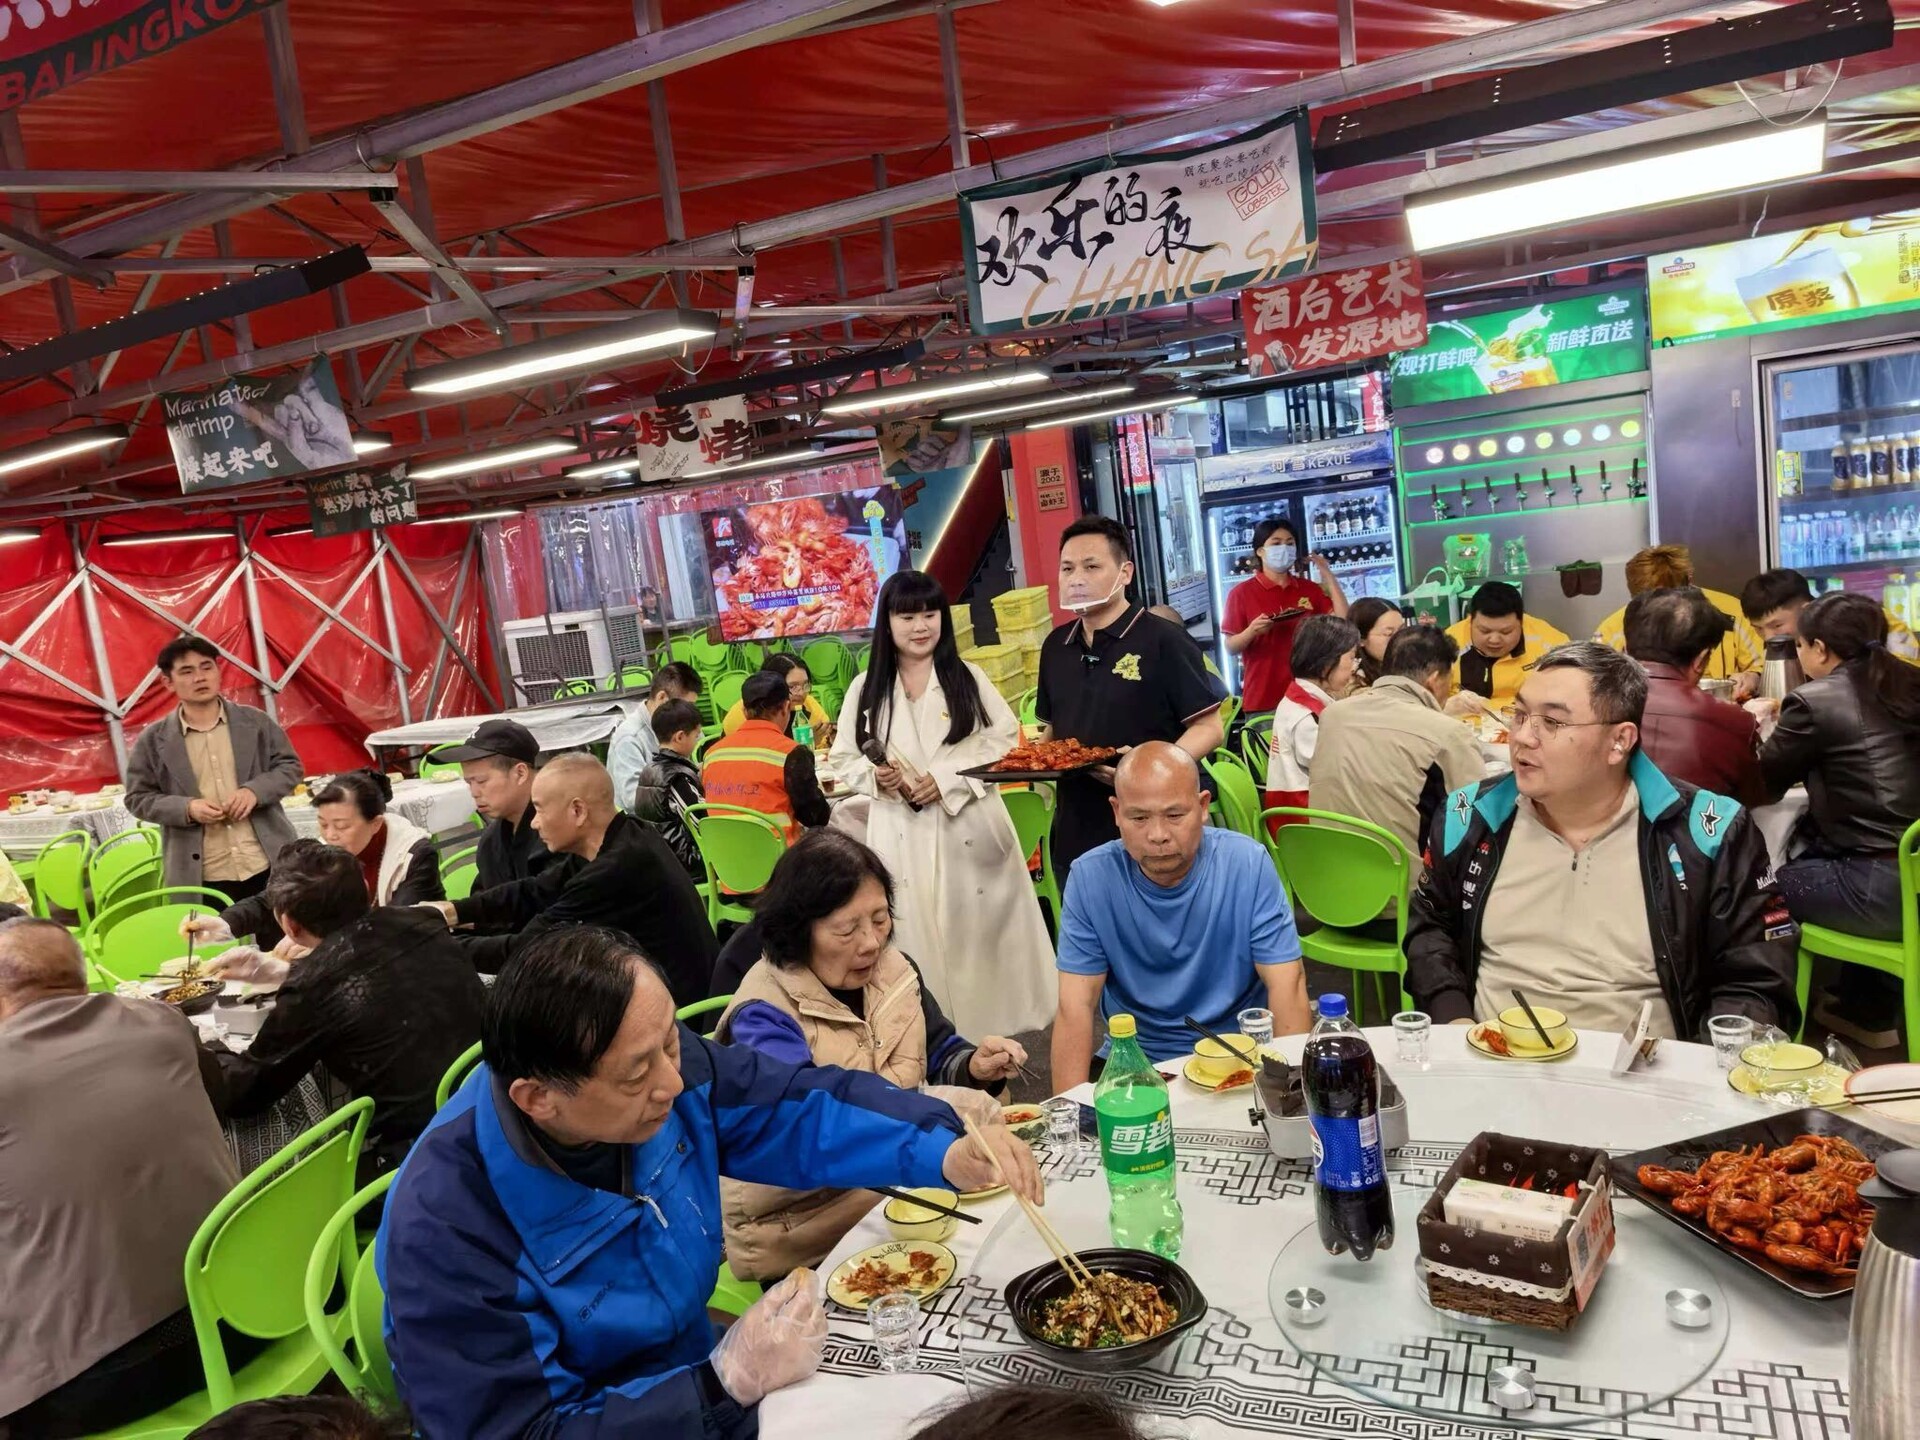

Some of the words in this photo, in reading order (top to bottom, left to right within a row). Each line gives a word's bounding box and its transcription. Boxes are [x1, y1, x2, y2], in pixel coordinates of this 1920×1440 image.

[1235, 160, 1275, 204] GOLD
[1242, 184, 1285, 216] LOBSTER
[1252, 258, 1420, 335] 酒后艺术
[1766, 286, 1835, 311] 原浆
[1299, 310, 1424, 366] 发源地
[1546, 318, 1634, 353] 新鲜直送
[1397, 346, 1478, 376] 现打鲜啤
[1308, 453, 1352, 469] KEXUE
[1041, 475, 1061, 484] 2002
[1109, 1113, 1171, 1155] 雪碧
